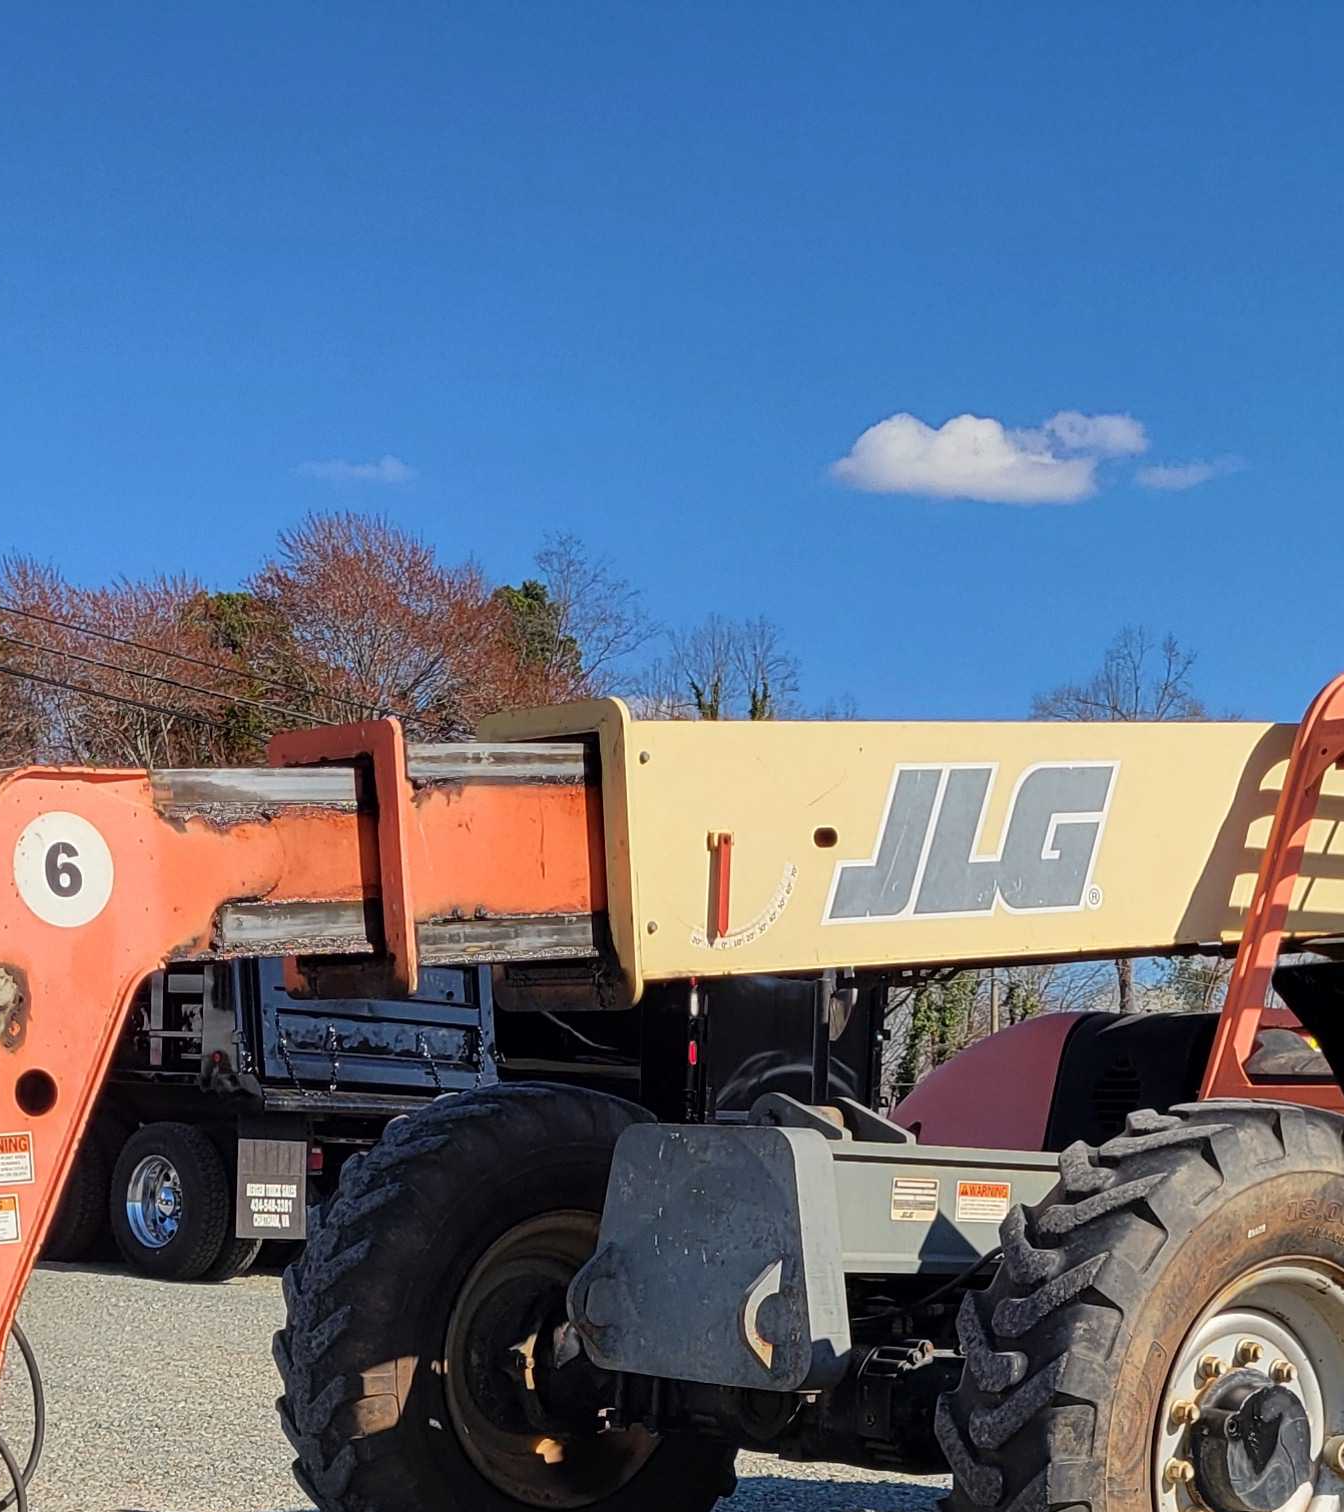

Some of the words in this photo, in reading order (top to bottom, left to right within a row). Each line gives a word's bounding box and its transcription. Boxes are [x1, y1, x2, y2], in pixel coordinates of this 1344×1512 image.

[44, 841, 83, 898] 6
[822, 761, 1120, 924] JLG
[968, 1184, 1009, 1198] WARNING
